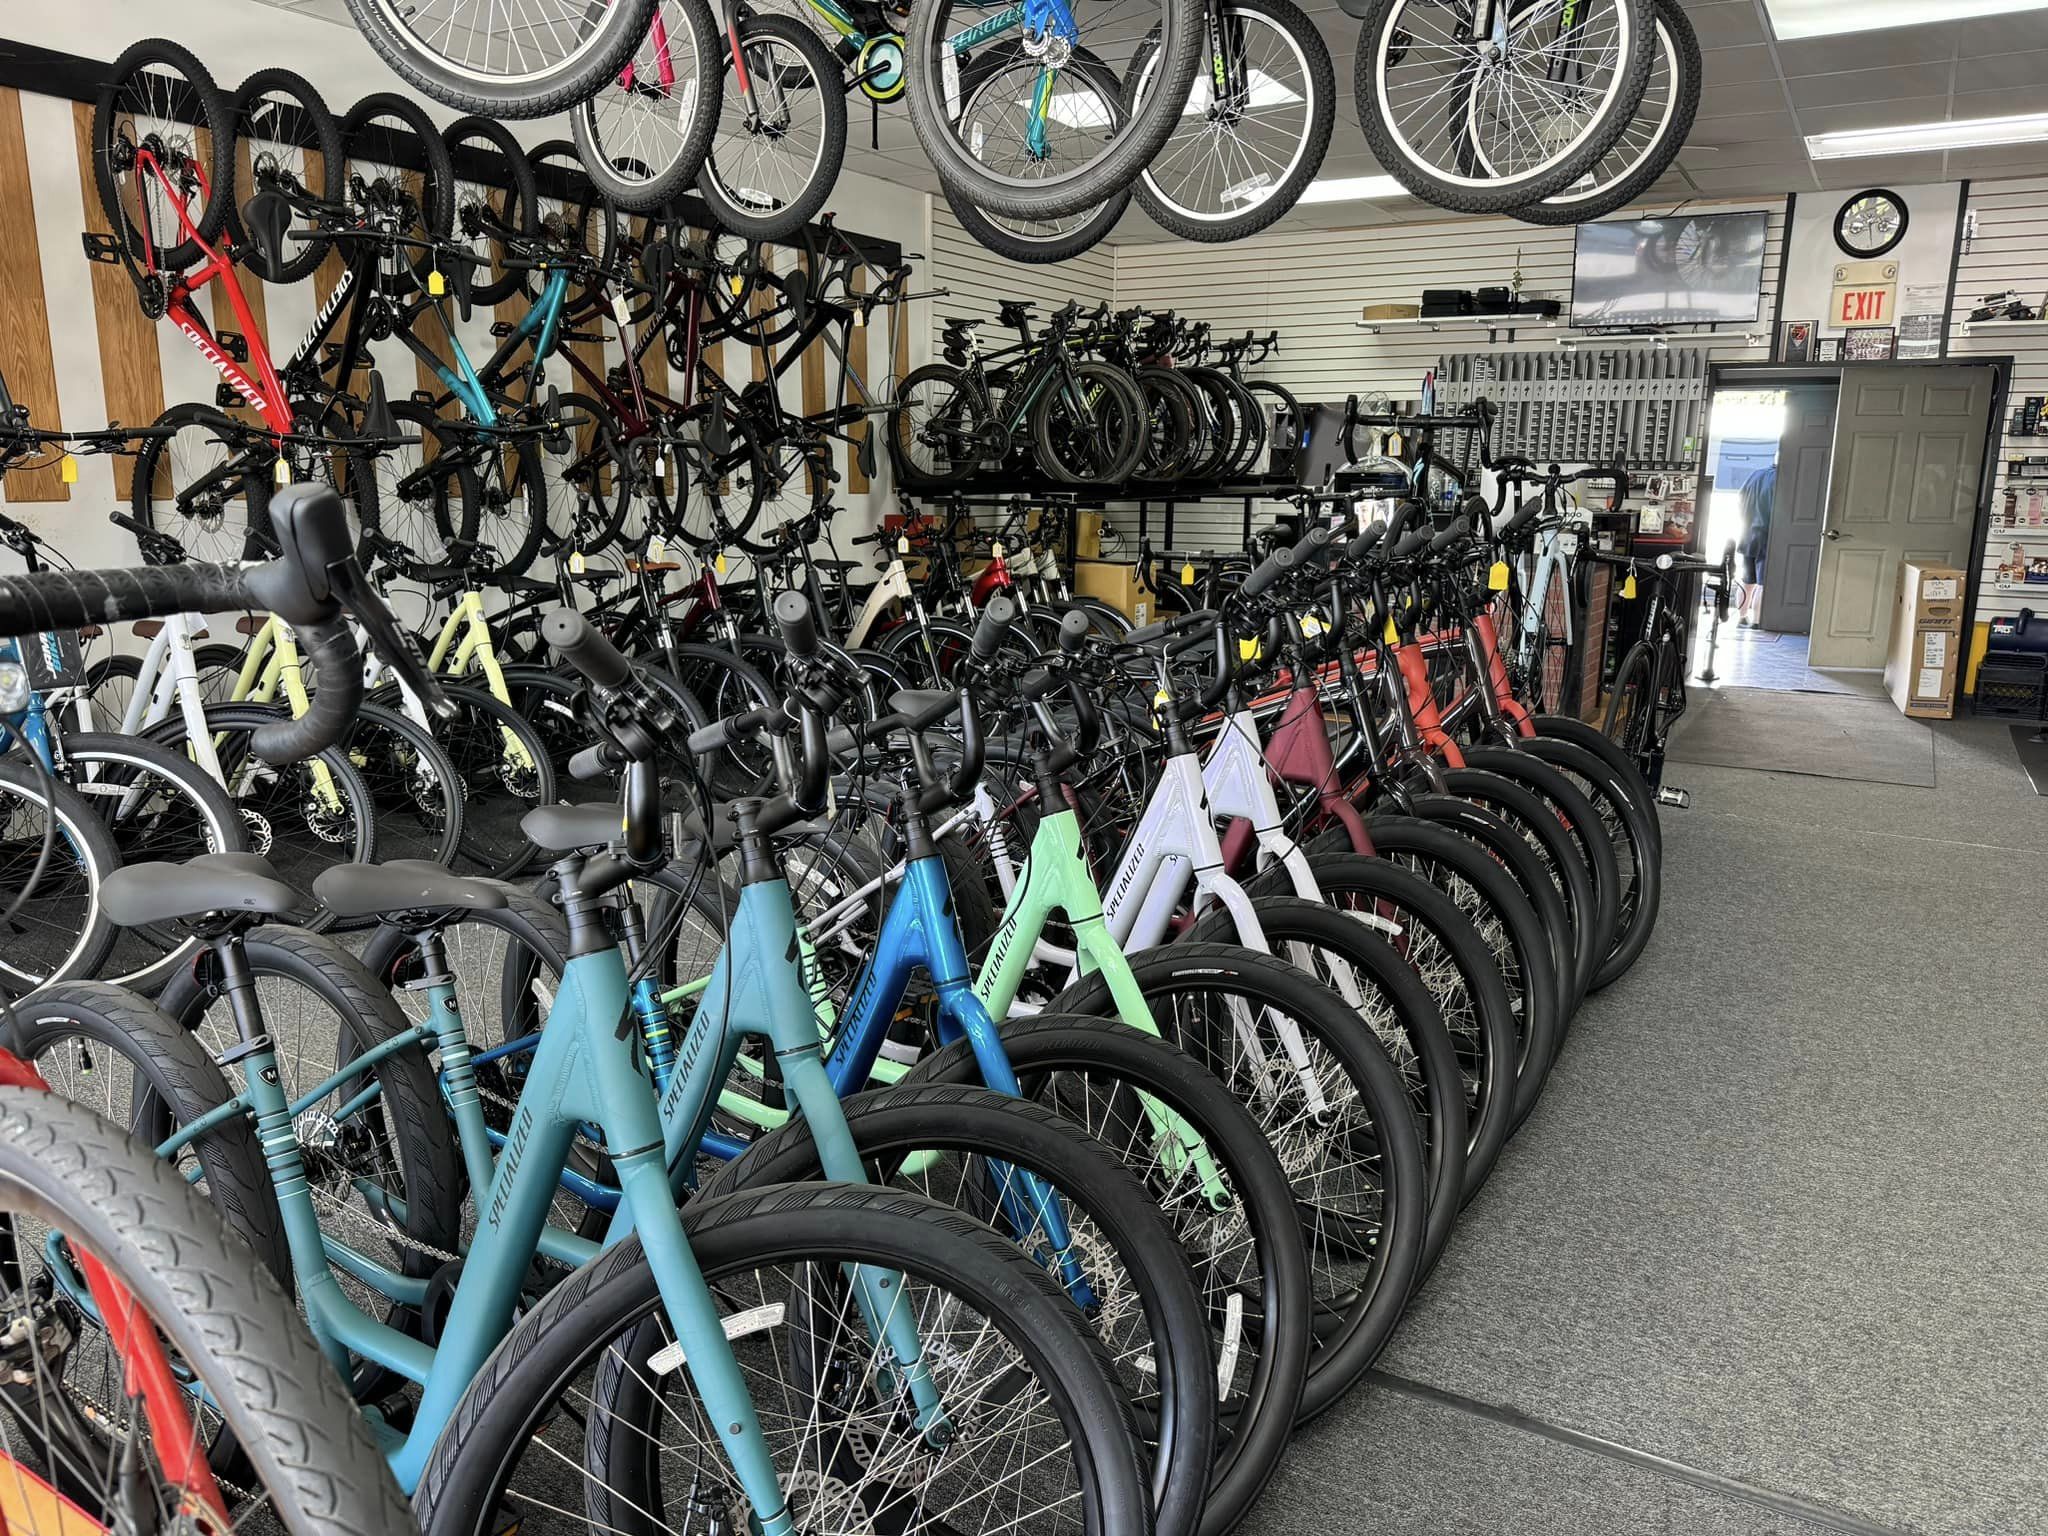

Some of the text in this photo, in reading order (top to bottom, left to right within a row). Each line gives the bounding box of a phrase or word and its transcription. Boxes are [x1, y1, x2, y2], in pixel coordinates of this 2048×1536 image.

[296, 270, 354, 361] SPECIALIZED
[1842, 291, 1886, 321] EXIT
[181, 322, 268, 412] SPECIALIZED
[1106, 842, 1145, 922] SPECIALIZED
[980, 917, 1017, 1003] SPECIALIZED
[835, 970, 877, 1064] SPECIALIZED
[265, 1069, 277, 1081] M
[663, 1009, 710, 1125] SPECIALIZED
[488, 1105, 533, 1234] SPECIALIZED
